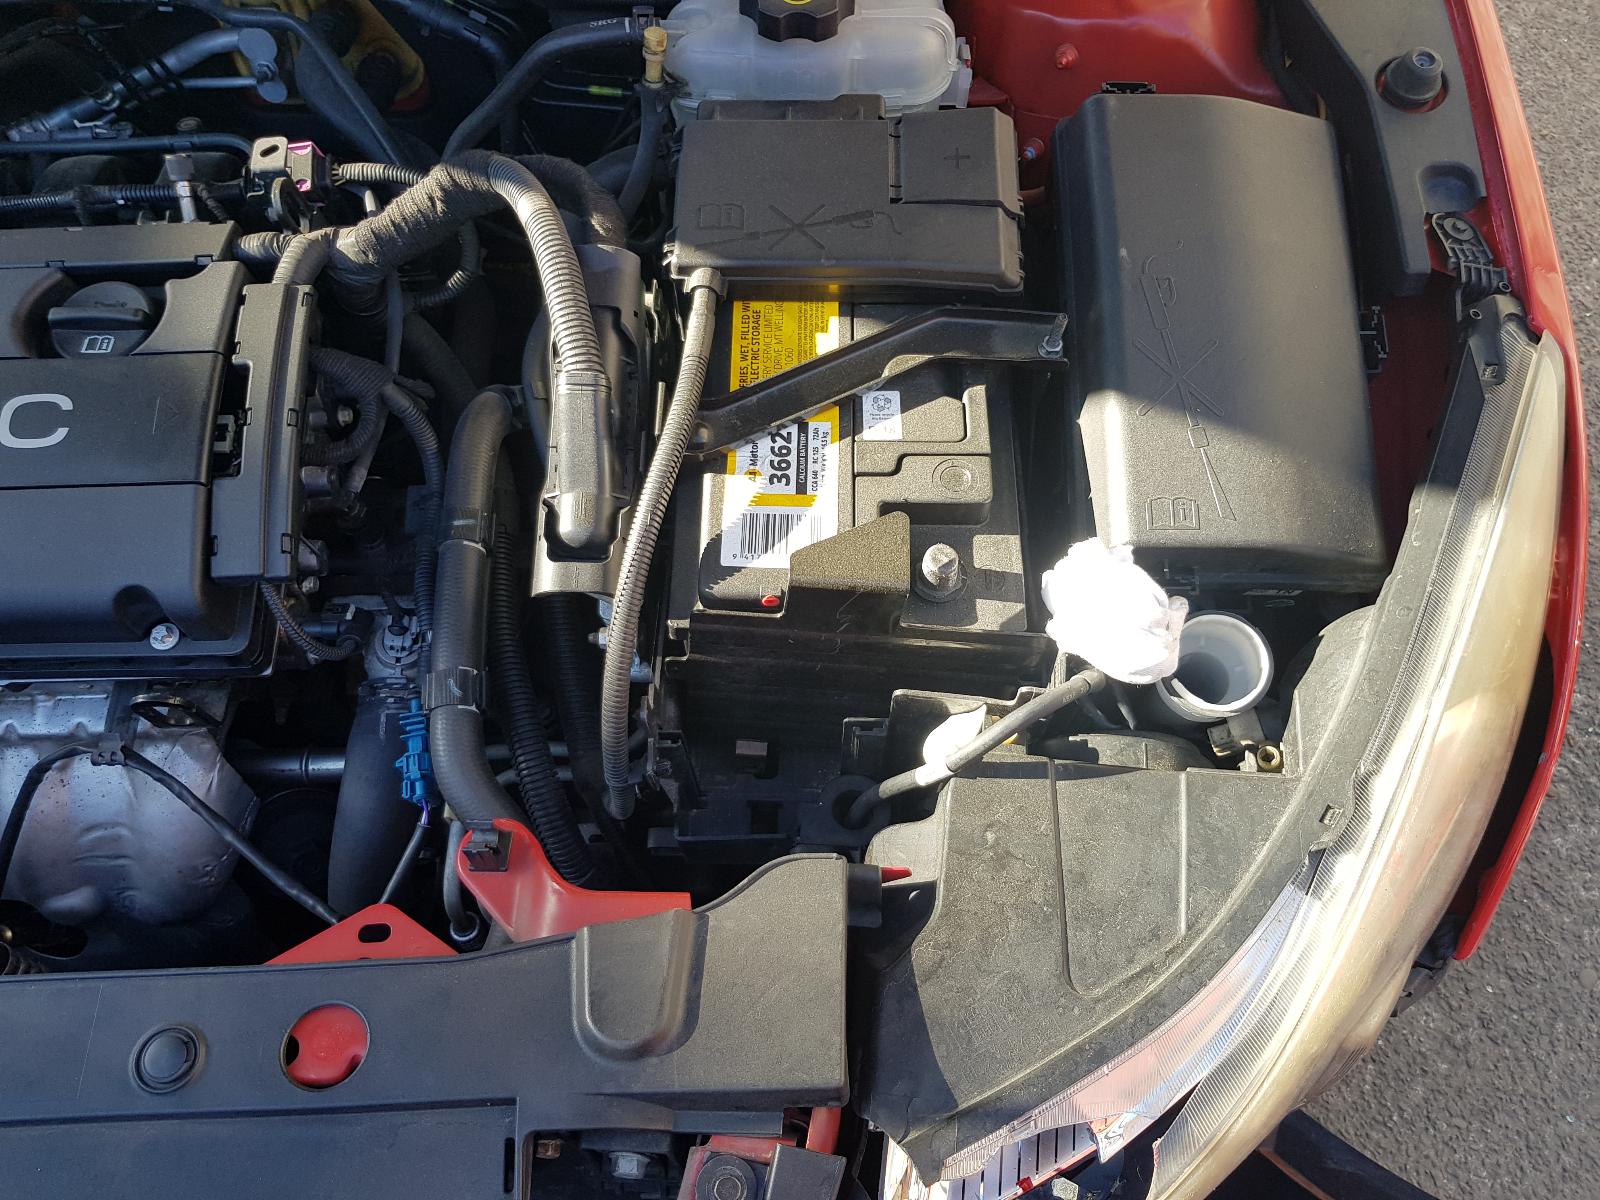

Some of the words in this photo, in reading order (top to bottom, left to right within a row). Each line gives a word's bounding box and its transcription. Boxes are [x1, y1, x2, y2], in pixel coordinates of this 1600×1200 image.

[740, 314, 750, 341] FILLED
[751, 309, 761, 346] STORAGE
[764, 304, 773, 333] LIMITED
[740, 342, 750, 362] WET,
[763, 334, 773, 364] SERVICE
[799, 432, 807, 457] BATTERY
[812, 427, 820, 441] 72Ah
[768, 431, 793, 487] 3662
[798, 457, 806, 483] CALCIUM
[812, 456, 819, 465] RC
[811, 469, 819, 480] 640
[811, 480, 819, 492] CCA
